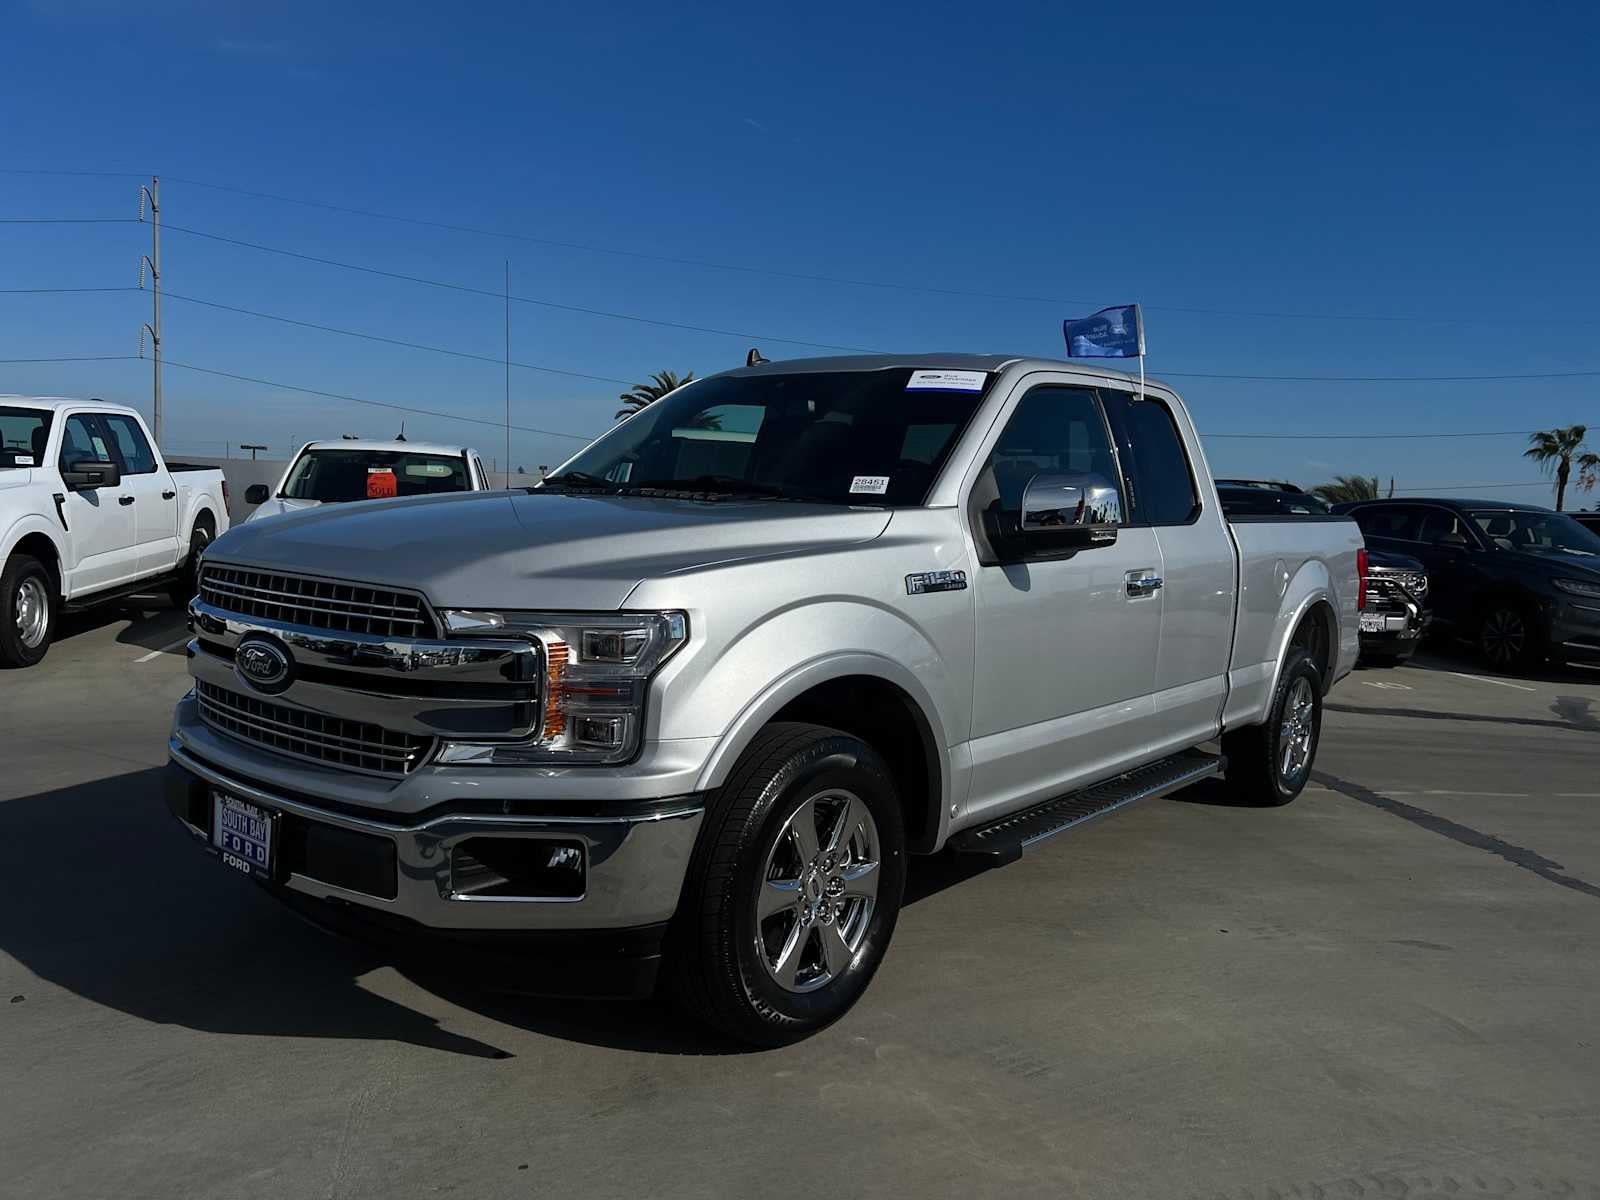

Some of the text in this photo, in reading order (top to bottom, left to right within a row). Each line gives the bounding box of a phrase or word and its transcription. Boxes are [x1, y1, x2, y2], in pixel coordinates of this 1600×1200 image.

[244, 648, 273, 675] Ford
[222, 807, 266, 841] SOUTH BAY
[222, 831, 265, 862] FORD
[223, 852, 251, 874] FORD
